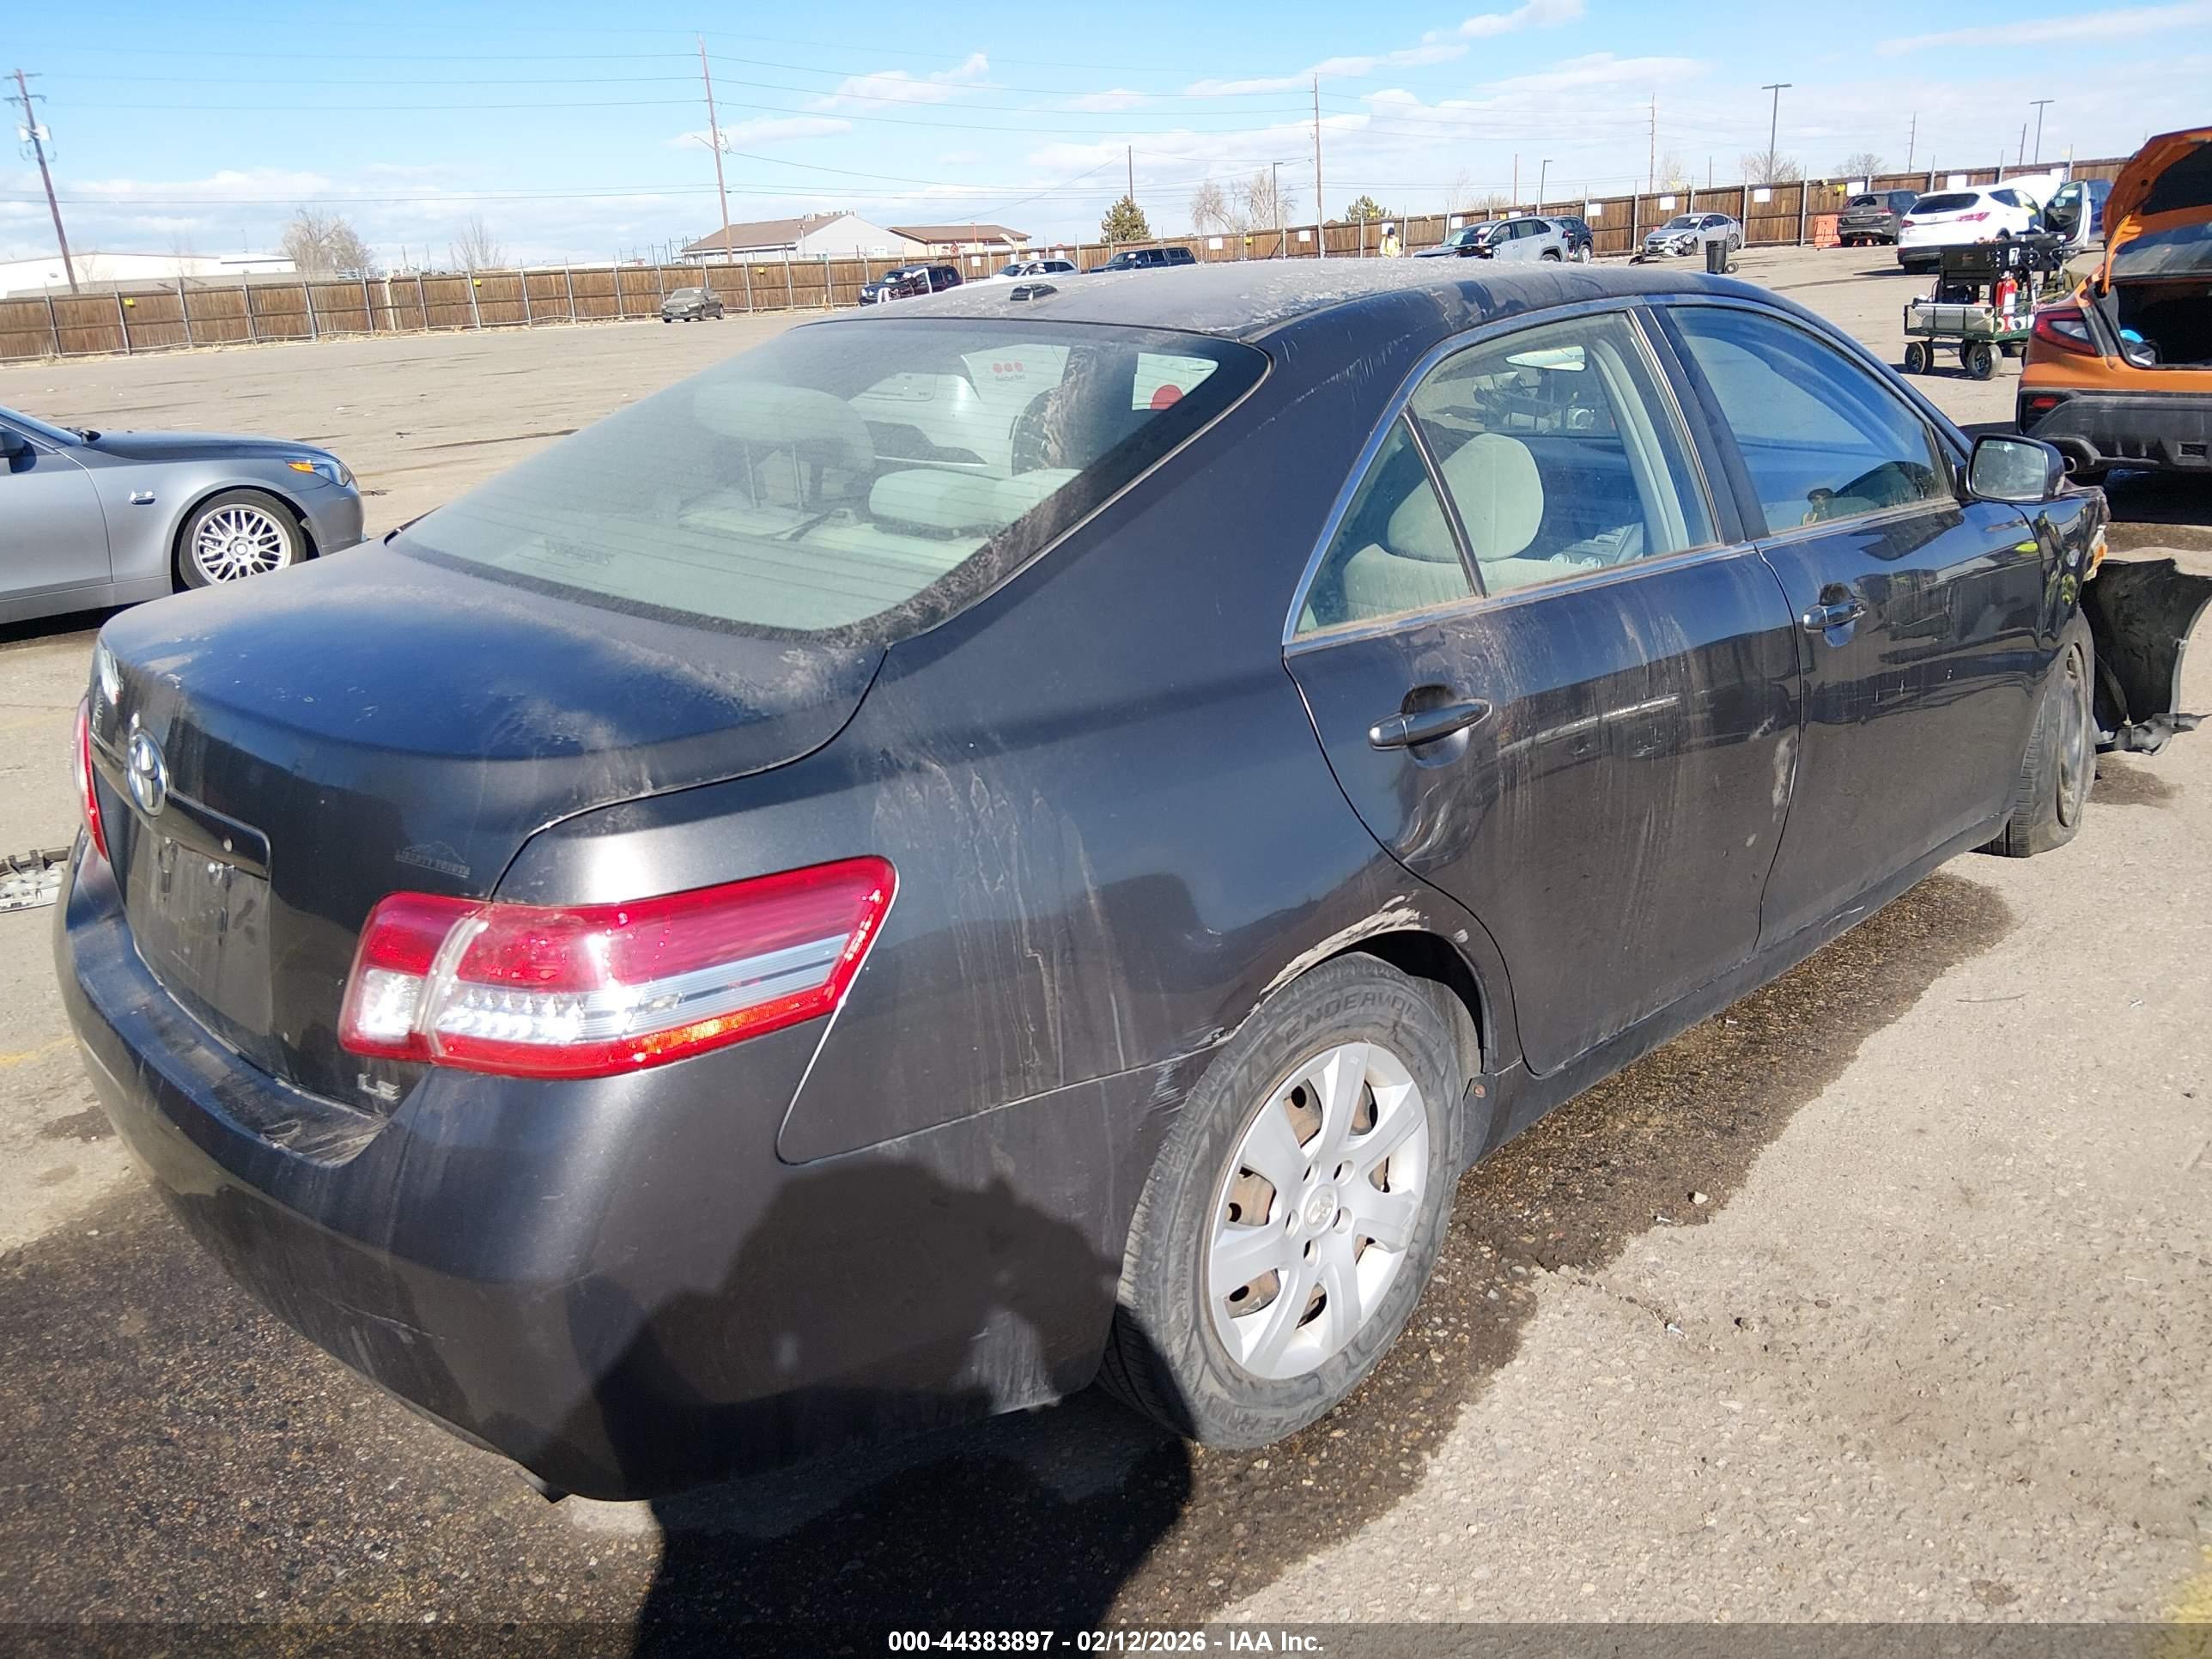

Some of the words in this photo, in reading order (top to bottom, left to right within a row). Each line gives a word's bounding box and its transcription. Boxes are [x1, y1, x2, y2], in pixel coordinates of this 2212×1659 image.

[2011, 249, 2018, 264] 7
[1285, 992, 1420, 1045] ENDEAVOR
[357, 1073, 401, 1101] LE
